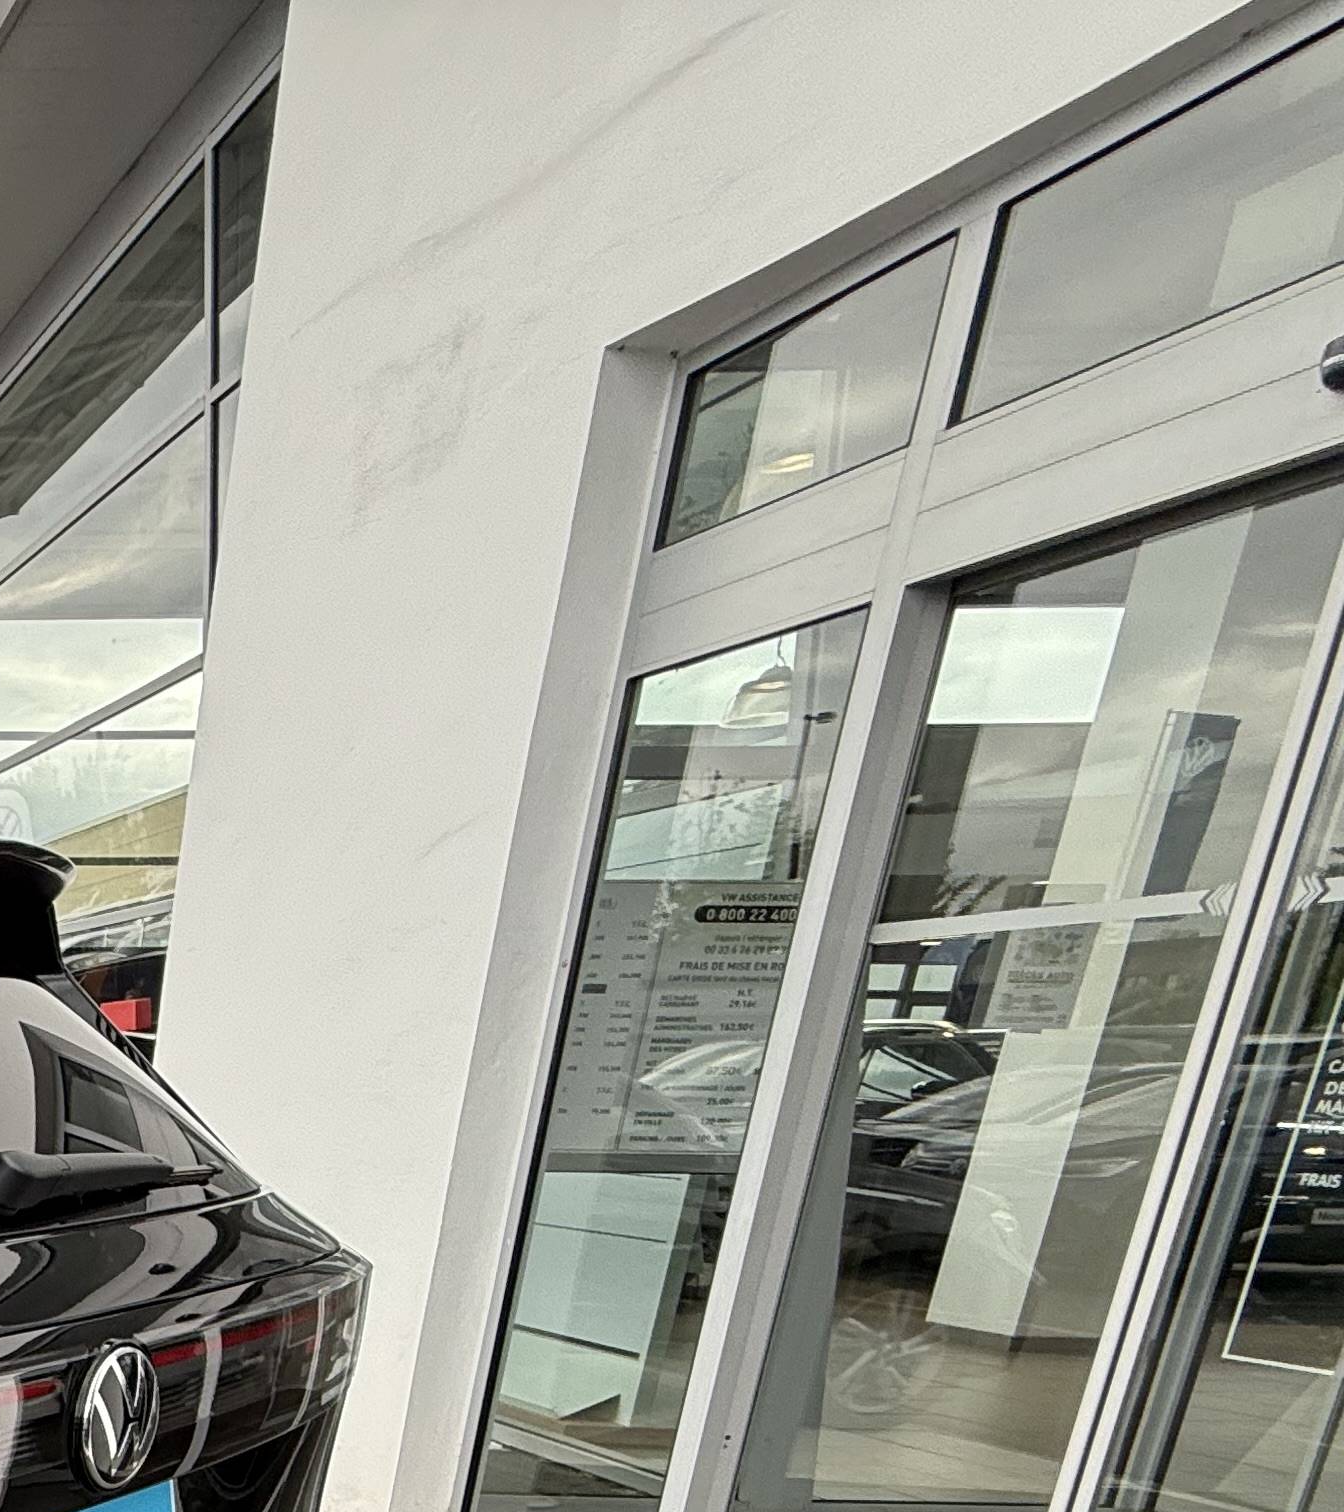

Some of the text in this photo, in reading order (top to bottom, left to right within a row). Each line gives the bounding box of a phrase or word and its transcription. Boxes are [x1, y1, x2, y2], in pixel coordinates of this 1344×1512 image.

[738, 893, 800, 902] ASSISTANCE
[706, 908, 716, 921] 0
[718, 908, 745, 921] 800
[748, 908, 767, 921] 22
[679, 962, 709, 972] FRAIS
[712, 962, 725, 971] DE
[727, 962, 751, 972] MISE
[754, 962, 768, 971] EN
[1298, 1172, 1343, 1188] FRAIS
[81, 1345, 160, 1491] VW
